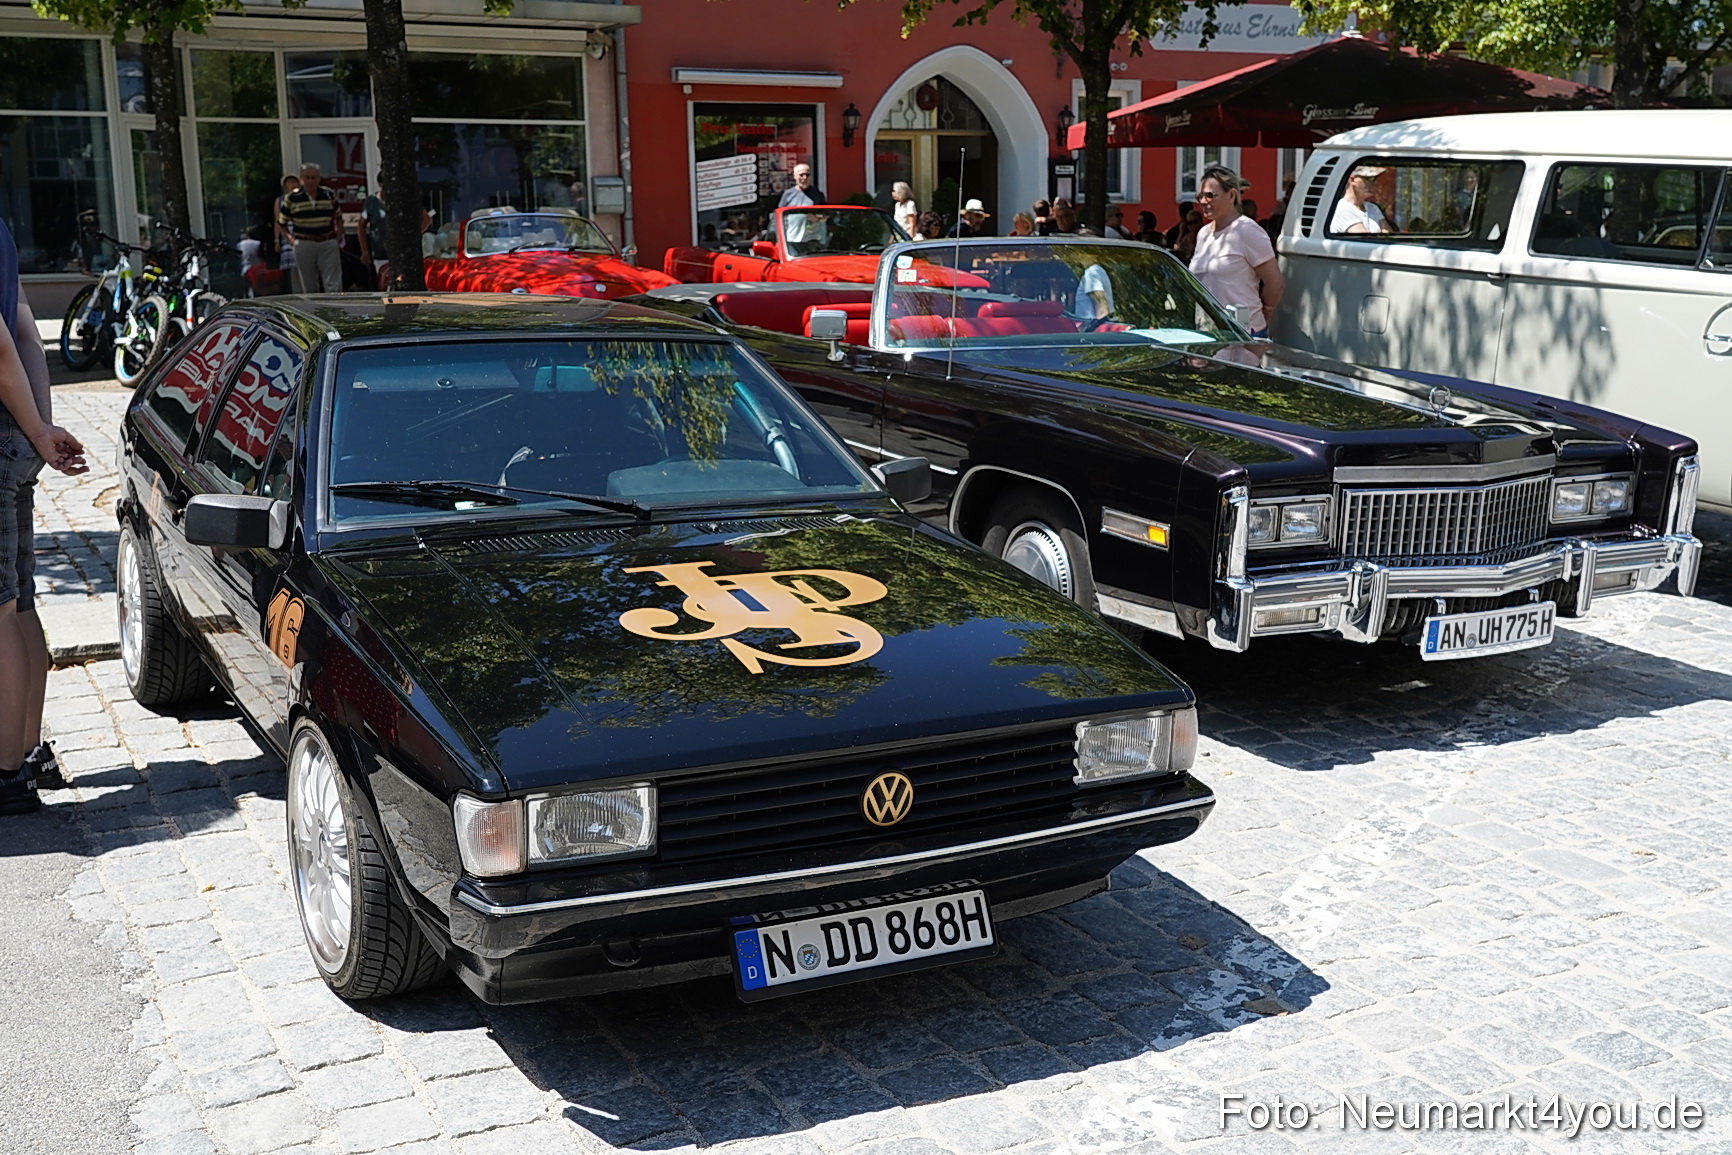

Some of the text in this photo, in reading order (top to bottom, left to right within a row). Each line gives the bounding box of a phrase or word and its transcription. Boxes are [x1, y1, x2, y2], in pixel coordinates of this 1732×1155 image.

[1439, 621, 1467, 650] AN
[863, 772, 914, 827] VW
[762, 929, 797, 979] N
[820, 916, 879, 968] DD
[884, 896, 989, 955] 868H
[747, 965, 758, 980] D
